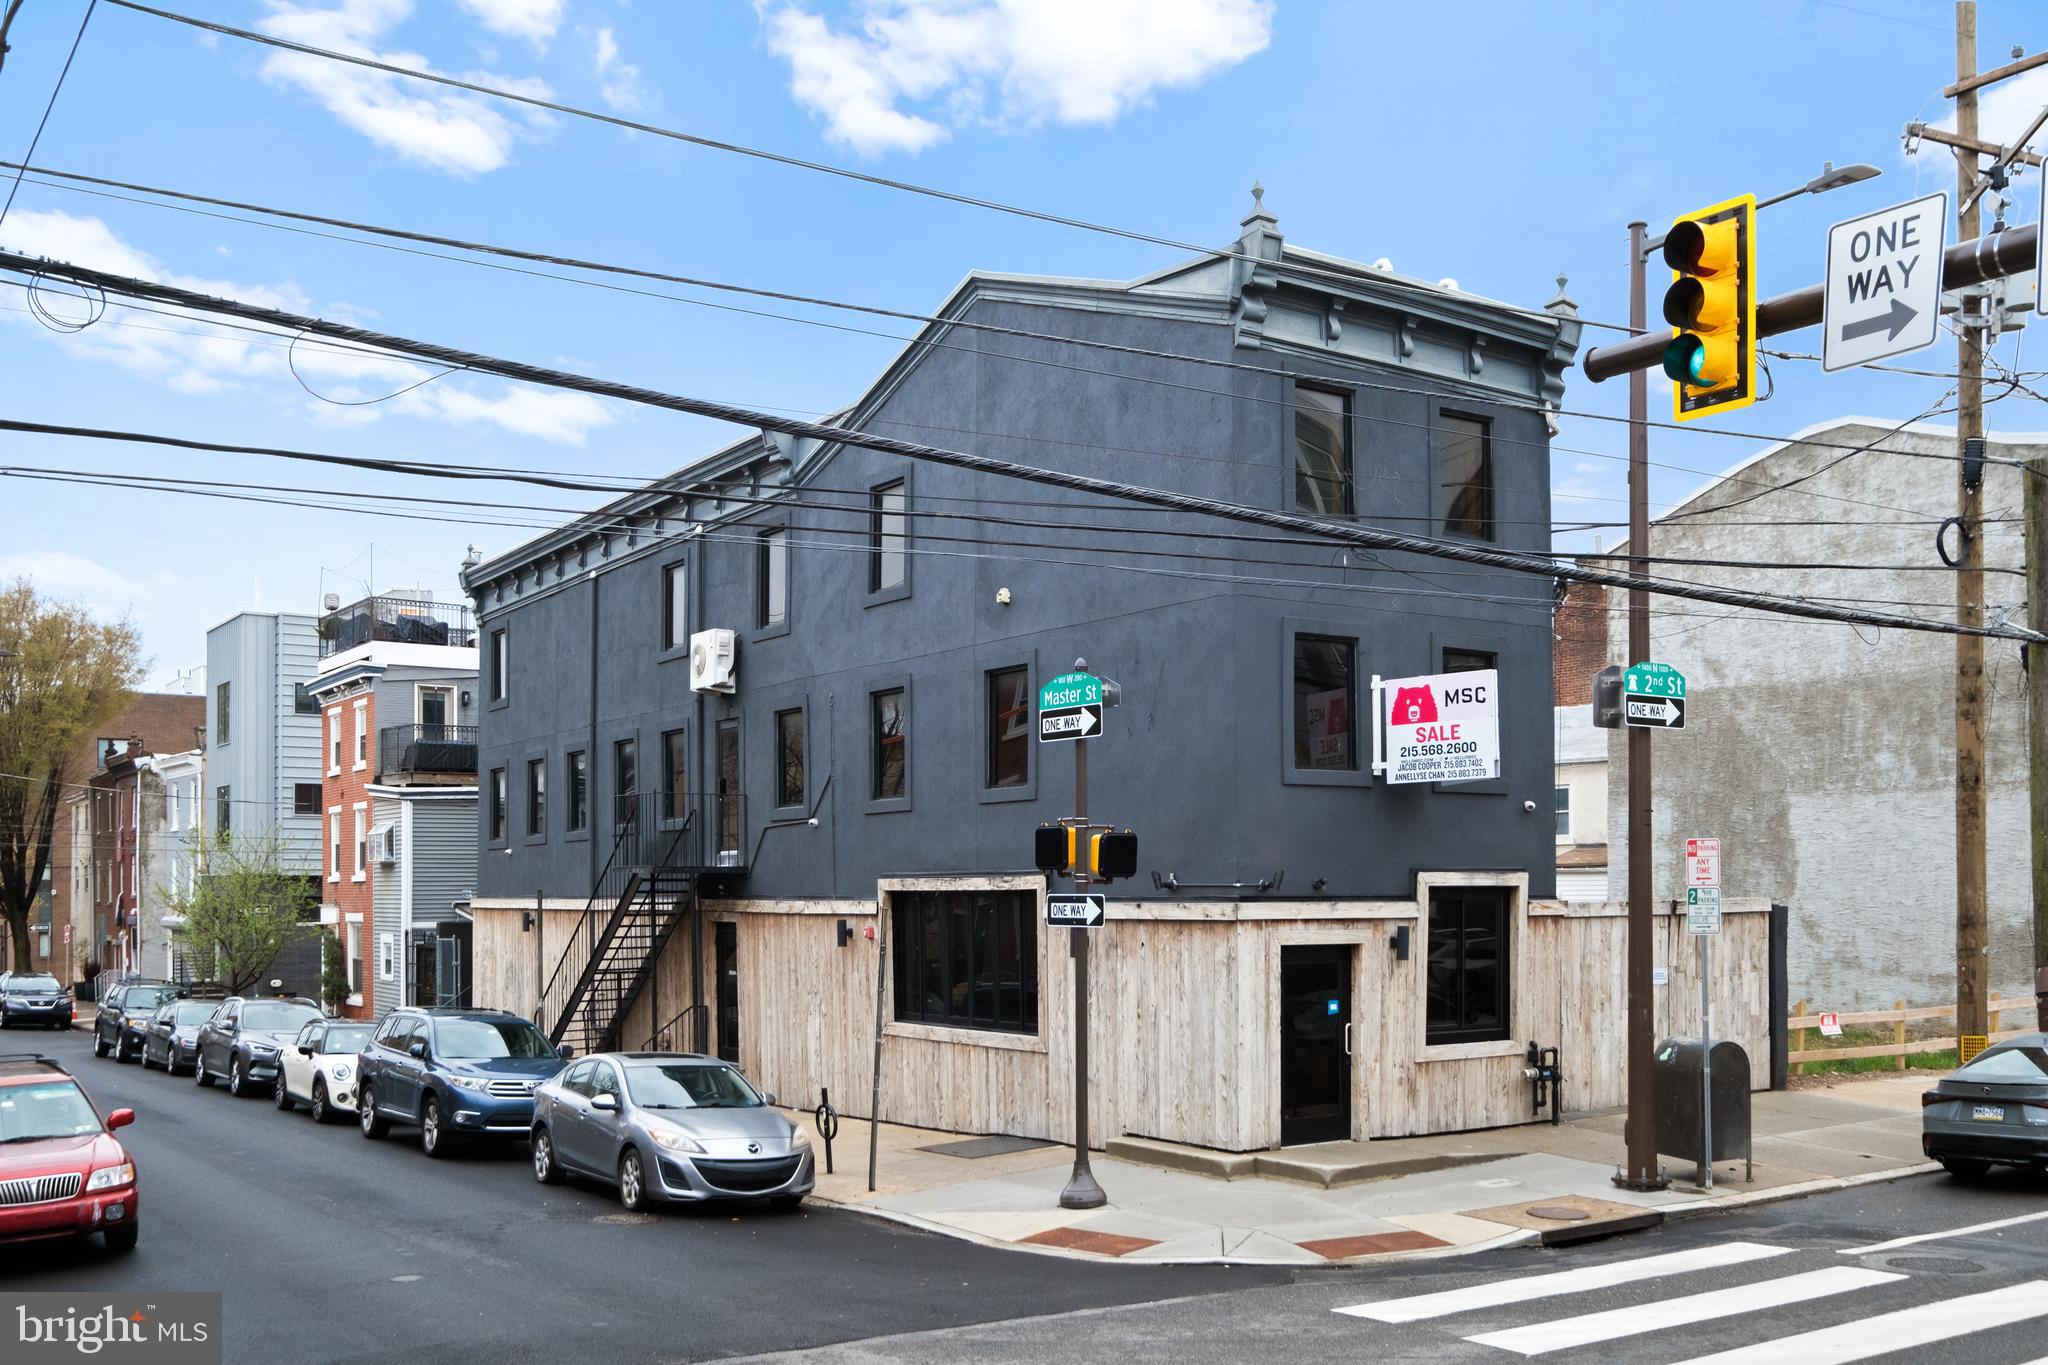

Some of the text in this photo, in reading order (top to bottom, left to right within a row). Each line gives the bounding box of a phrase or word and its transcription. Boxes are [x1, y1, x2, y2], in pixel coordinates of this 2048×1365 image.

[1851, 214, 1921, 263] ONE
[1848, 254, 1920, 304] WAY
[1653, 664, 1658, 673] N
[1067, 674, 1074, 684] W
[1645, 675, 1682, 695] 2nd St
[1045, 684, 1097, 706] Master St
[1445, 687, 1486, 707] MSC
[1631, 704, 1666, 717] ONE WAY
[1045, 716, 1081, 731] ONE WAY
[1416, 724, 1461, 743] SALE
[1400, 742, 1477, 757] 215.568.2600
[1398, 762, 1417, 772] JACOB
[1418, 761, 1441, 770] COOPER
[1395, 772, 1427, 781] ANNELLYSE
[1428, 771, 1445, 779] CHAN
[1688, 844, 1697, 853] NO
[1696, 867, 1711, 875] TIME
[1690, 890, 1696, 903] 2
[1053, 905, 1086, 916] ONE WAY
